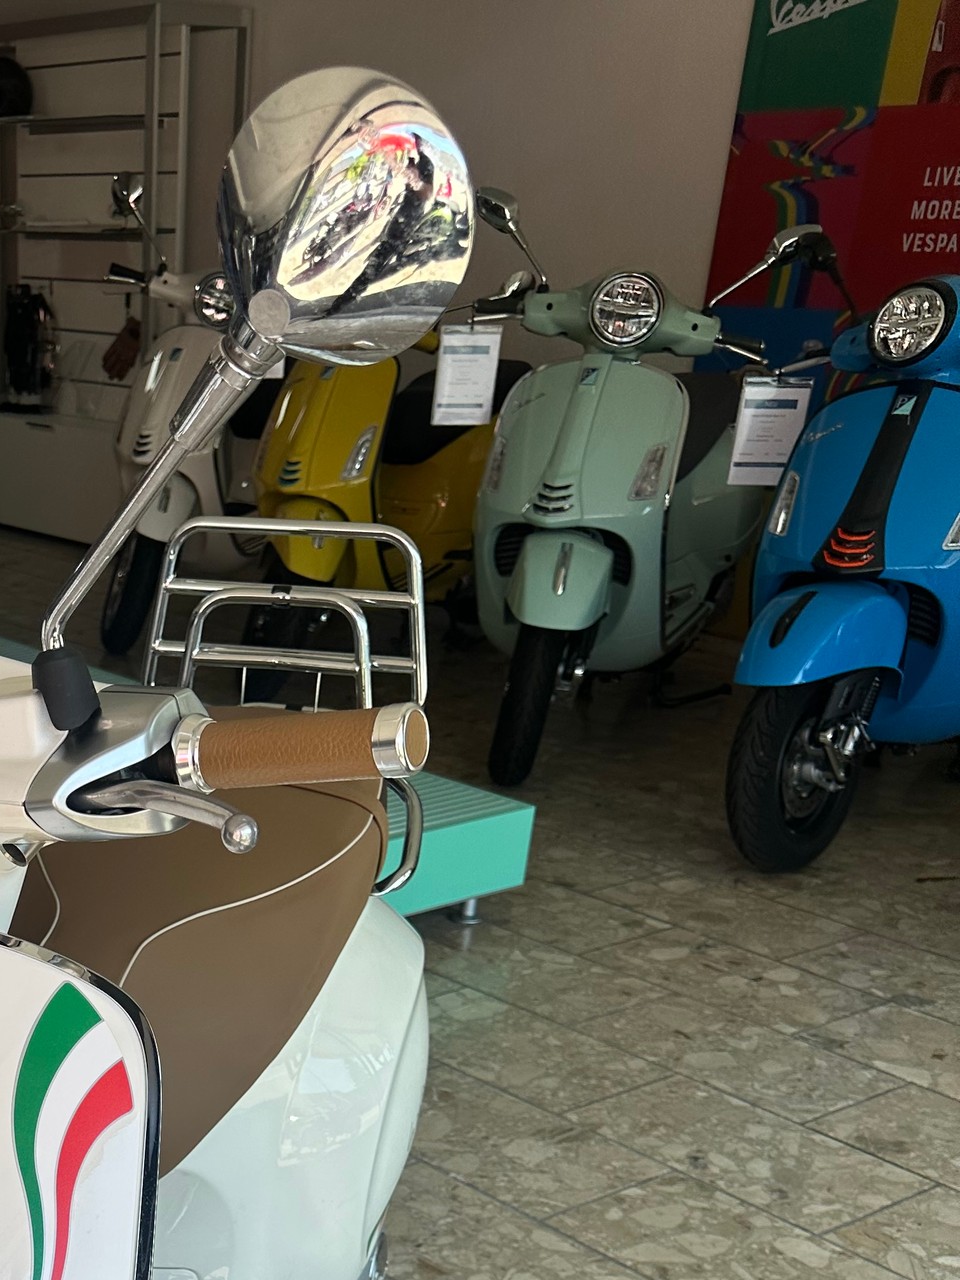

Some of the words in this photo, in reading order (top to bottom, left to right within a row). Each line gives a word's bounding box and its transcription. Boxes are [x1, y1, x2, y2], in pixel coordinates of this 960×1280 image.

[767, 0, 868, 36] Vesp
[923, 166, 960, 187] LIVE
[910, 200, 960, 220] MORE
[902, 232, 958, 253] VESPA
